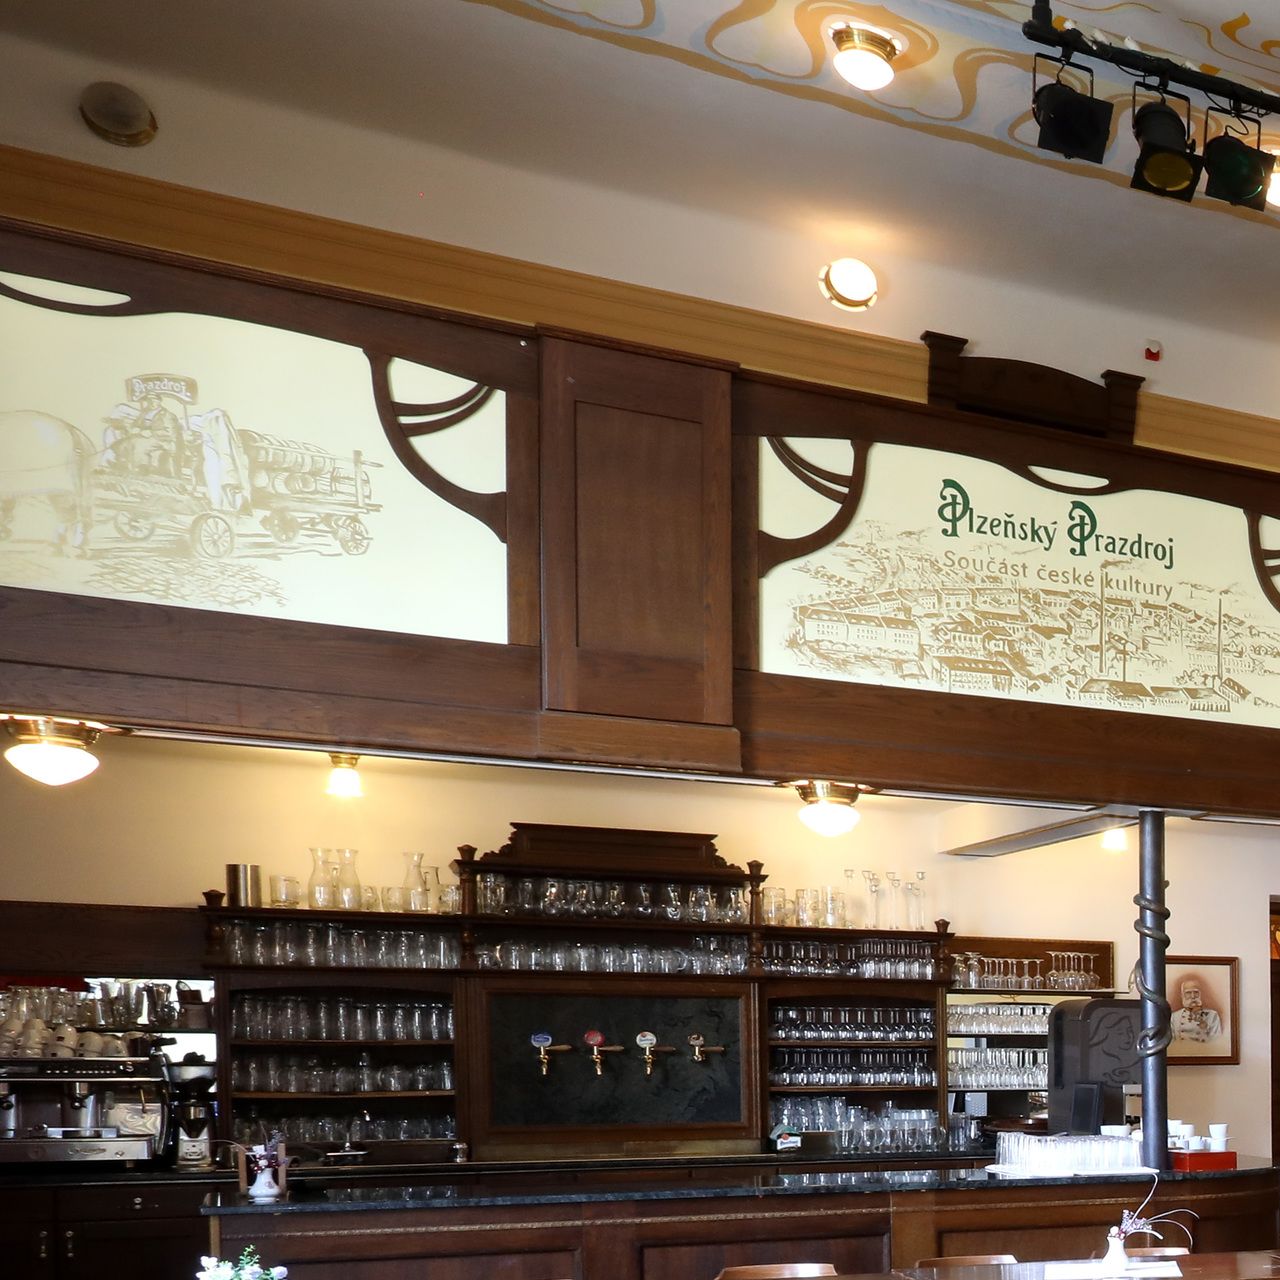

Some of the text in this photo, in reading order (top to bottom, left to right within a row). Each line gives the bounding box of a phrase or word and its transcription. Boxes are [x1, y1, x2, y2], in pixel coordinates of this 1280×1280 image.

[937, 478, 1174, 570] Plzeňský Prazdroj
[943, 550, 1173, 601] Součást české kultury
